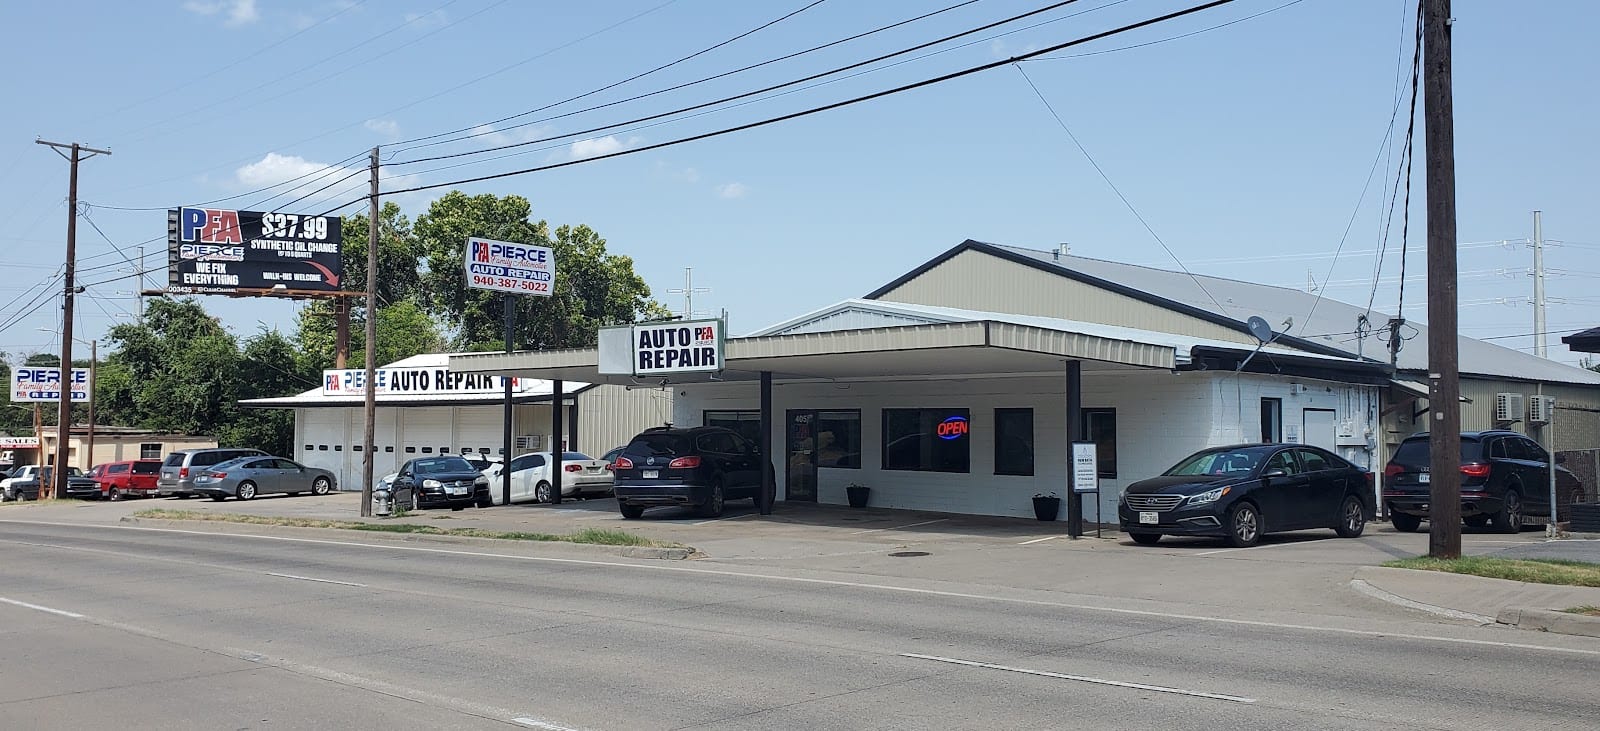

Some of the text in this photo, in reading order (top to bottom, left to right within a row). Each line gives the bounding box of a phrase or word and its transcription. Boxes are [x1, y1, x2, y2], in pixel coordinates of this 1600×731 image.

[181, 207, 243, 244] PFA
[262, 213, 328, 240] $37.99
[180, 245, 244, 256] PIERCE
[250, 240, 338, 253] SYNTHETIC OIL CHANGE
[472, 242, 488, 262] PFA
[491, 245, 546, 262] PIERCE
[196, 262, 226, 274] WE FIX
[472, 265, 549, 280] AUTO REPAIR
[183, 273, 239, 286] EVERYTHING
[262, 272, 322, 282] WALK-INS WELCOME
[474, 276, 548, 291] 940-387-5022
[639, 326, 714, 349] AUTO PFA
[639, 348, 714, 369] REPAIR
[17, 370, 86, 383] PIERE
[326, 374, 340, 390] PFA
[345, 370, 386, 387] PIEE
[391, 370, 429, 391] AUTO
[435, 369, 493, 390] REPAIR
[937, 421, 968, 436] OPEN
